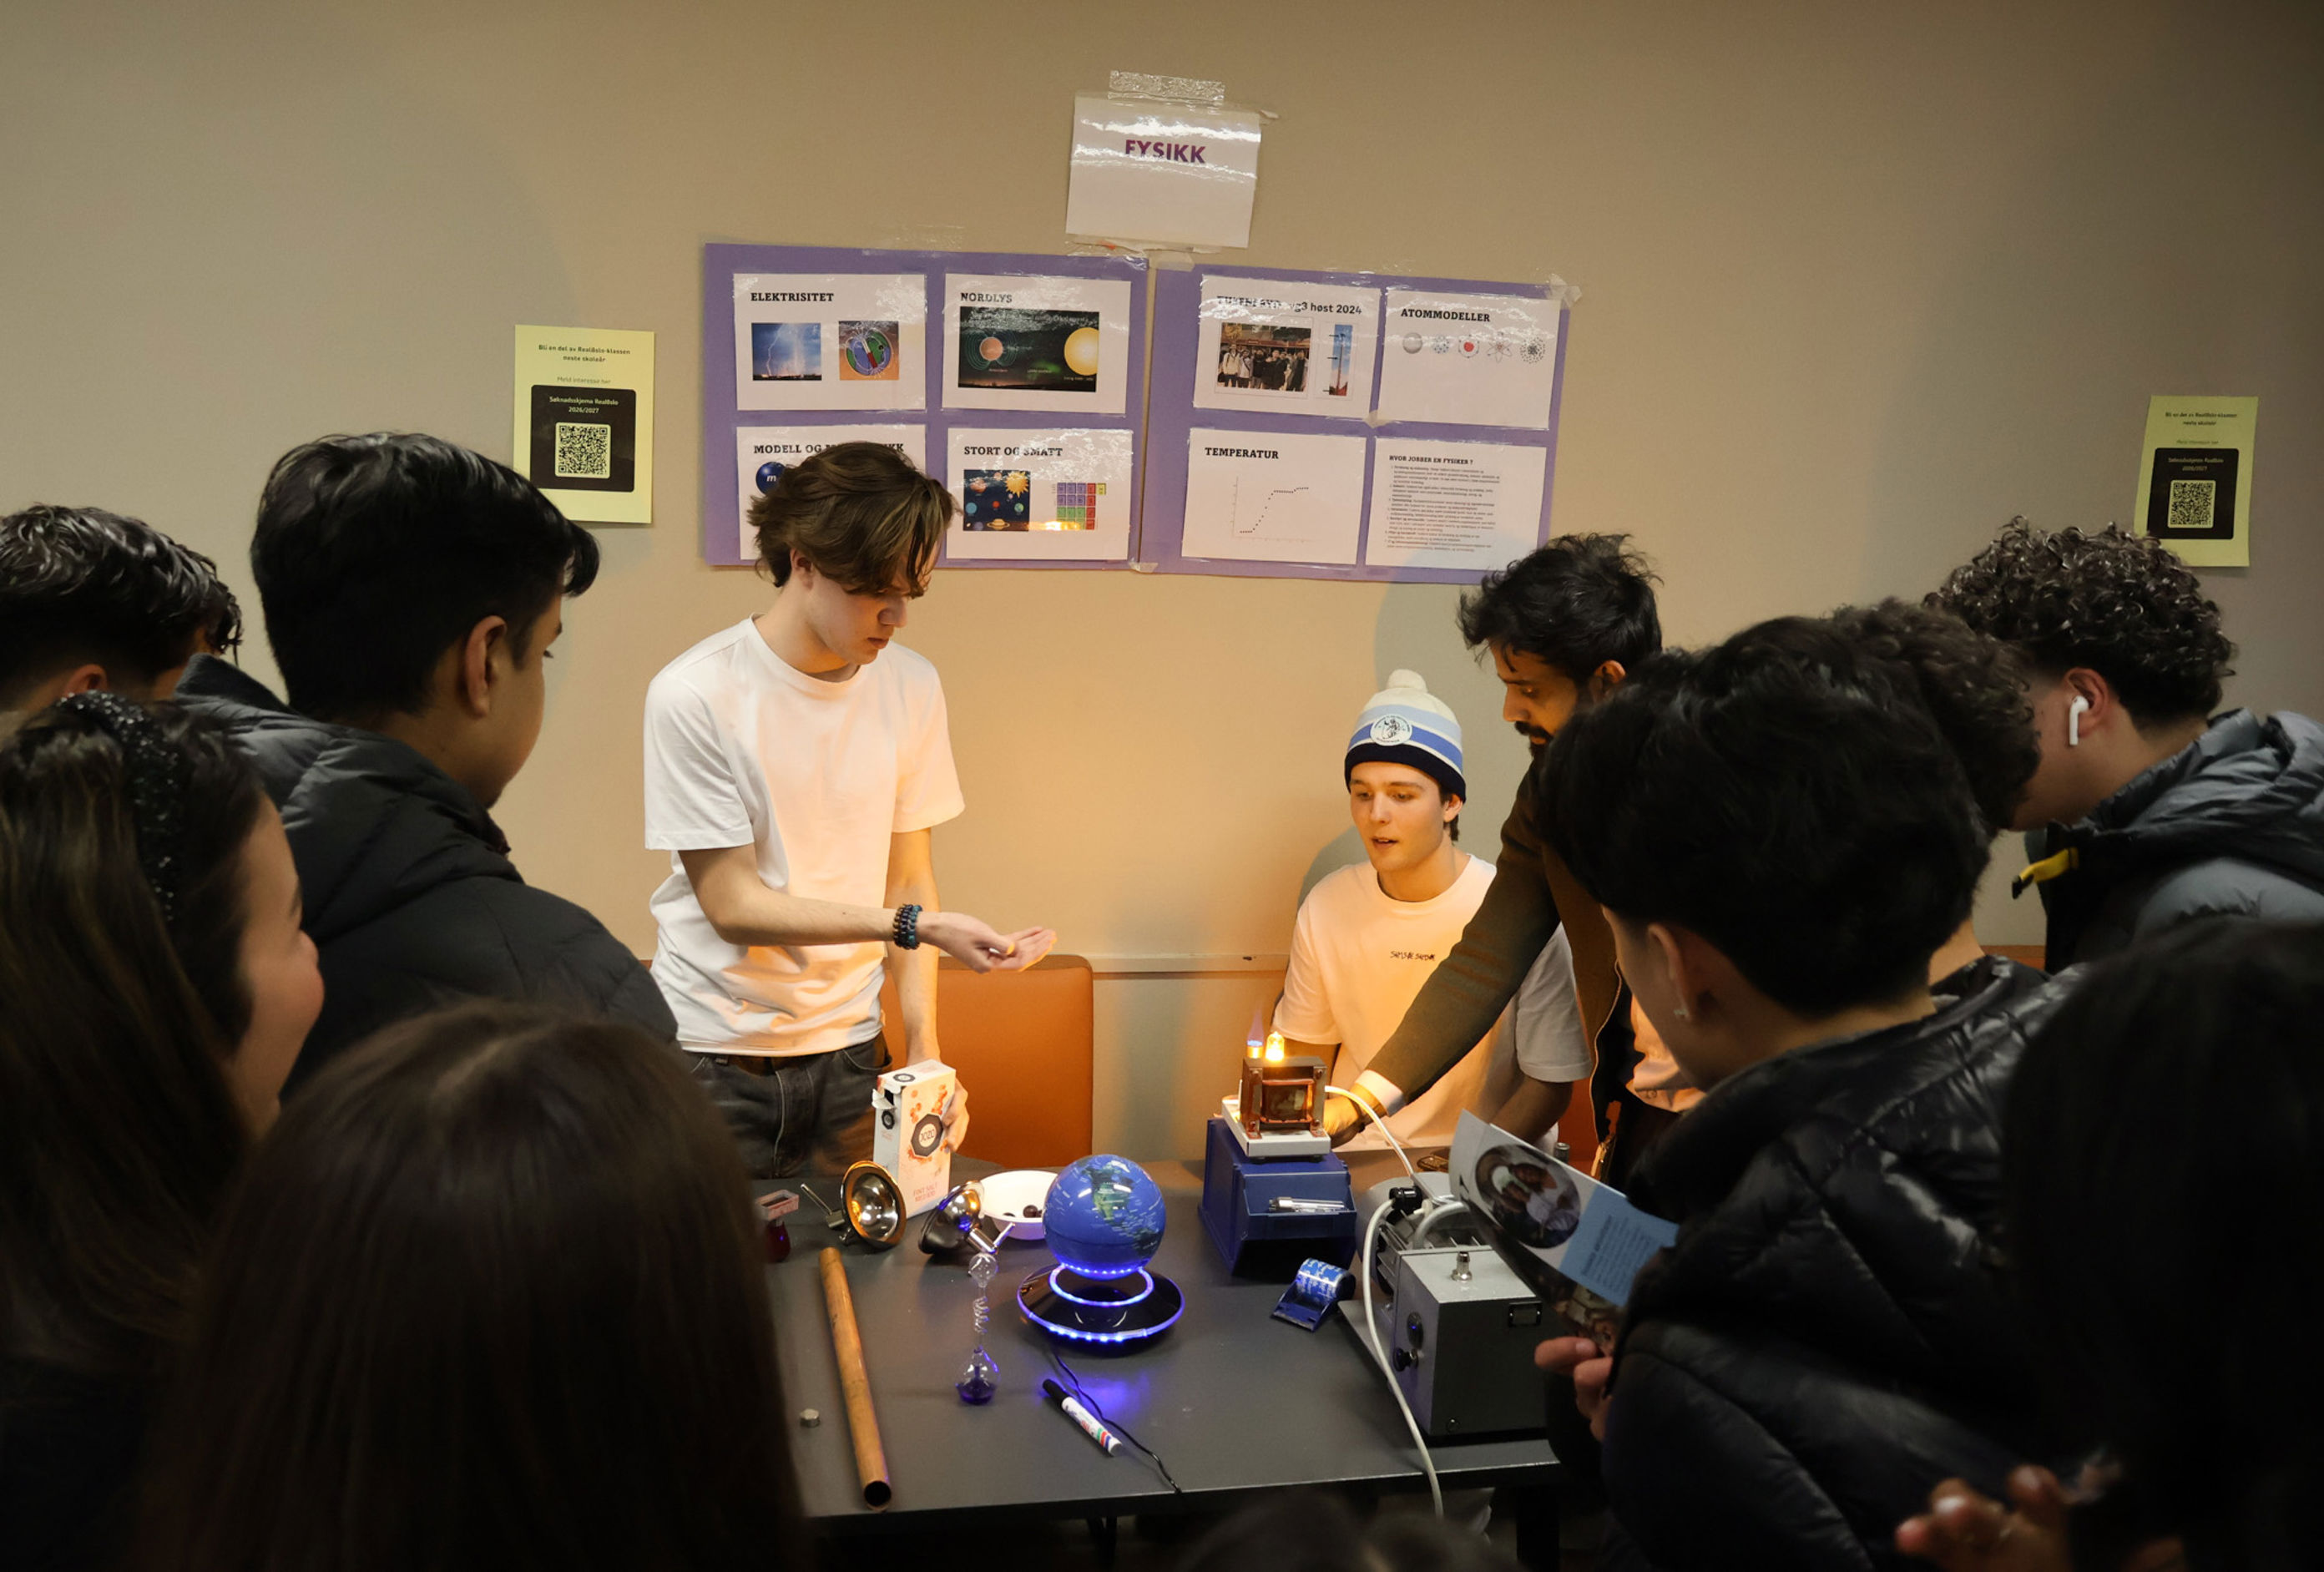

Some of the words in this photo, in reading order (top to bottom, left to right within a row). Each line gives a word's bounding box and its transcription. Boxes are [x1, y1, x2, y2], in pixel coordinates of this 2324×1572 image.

[1124, 139, 1206, 164] FYSIKK
[750, 292, 835, 301] ELEKTRISITET
[960, 292, 1013, 303] NORDLYS
[1311, 302, 1334, 313] høst
[1336, 304, 1362, 315] 2024
[1400, 308, 1491, 322] ATOMMODELLER
[754, 444, 802, 454] MODELL
[806, 444, 821, 453] OG
[963, 446, 1001, 456] STORT
[1003, 447, 1020, 456] OG
[1204, 447, 1279, 460] TEMPERATUR
